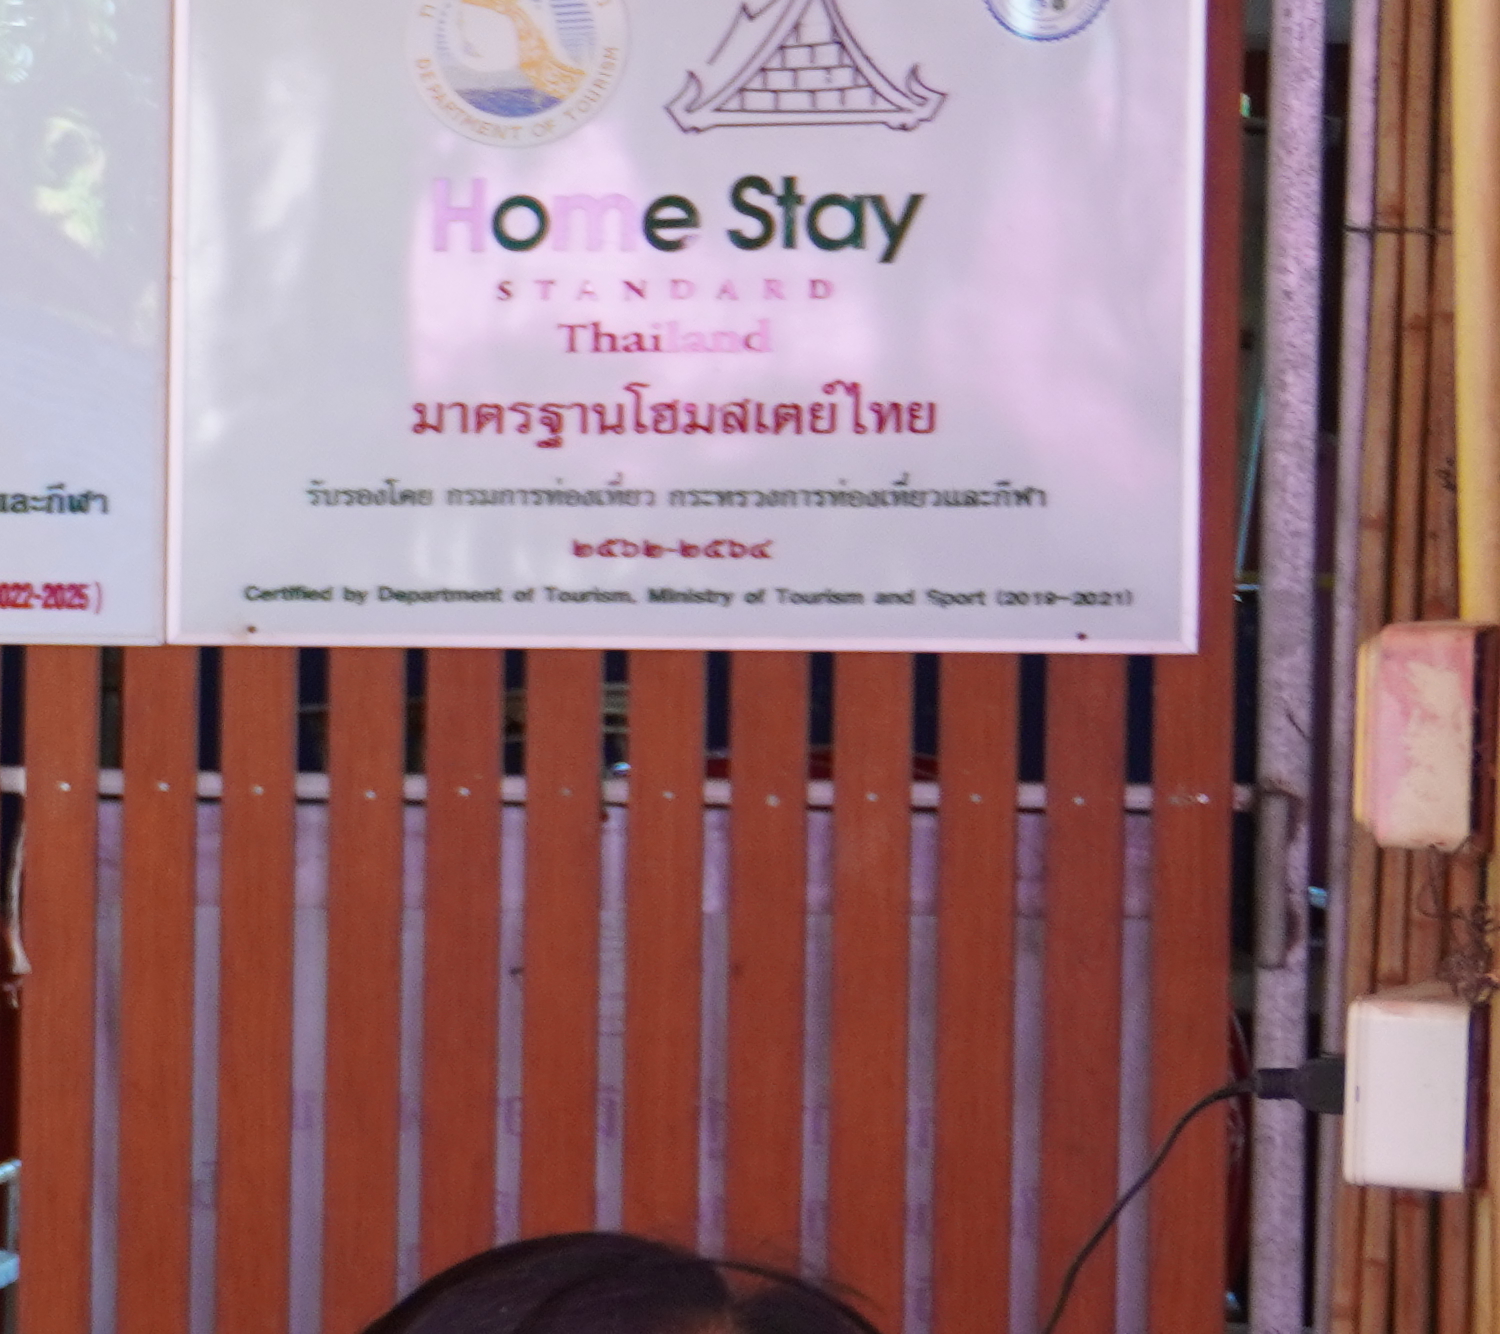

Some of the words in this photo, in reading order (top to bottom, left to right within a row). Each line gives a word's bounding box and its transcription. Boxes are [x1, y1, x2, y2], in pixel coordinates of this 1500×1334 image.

[431, 177, 699, 254] Home
[727, 175, 926, 263] Stay
[495, 277, 837, 302] STANDARD
[556, 320, 772, 355] Thailand
[411, 381, 938, 449] มาตรฐานโฮมสเตย์ไทย
[244, 584, 334, 602] Certified
[343, 584, 368, 606] by
[377, 585, 503, 606] Department
[513, 586, 535, 604] of
[647, 587, 733, 609] Ministry
[743, 588, 766, 605] of
[774, 588, 865, 605] Tourism
[874, 589, 915, 605] and
[925, 589, 987, 609] Sport
